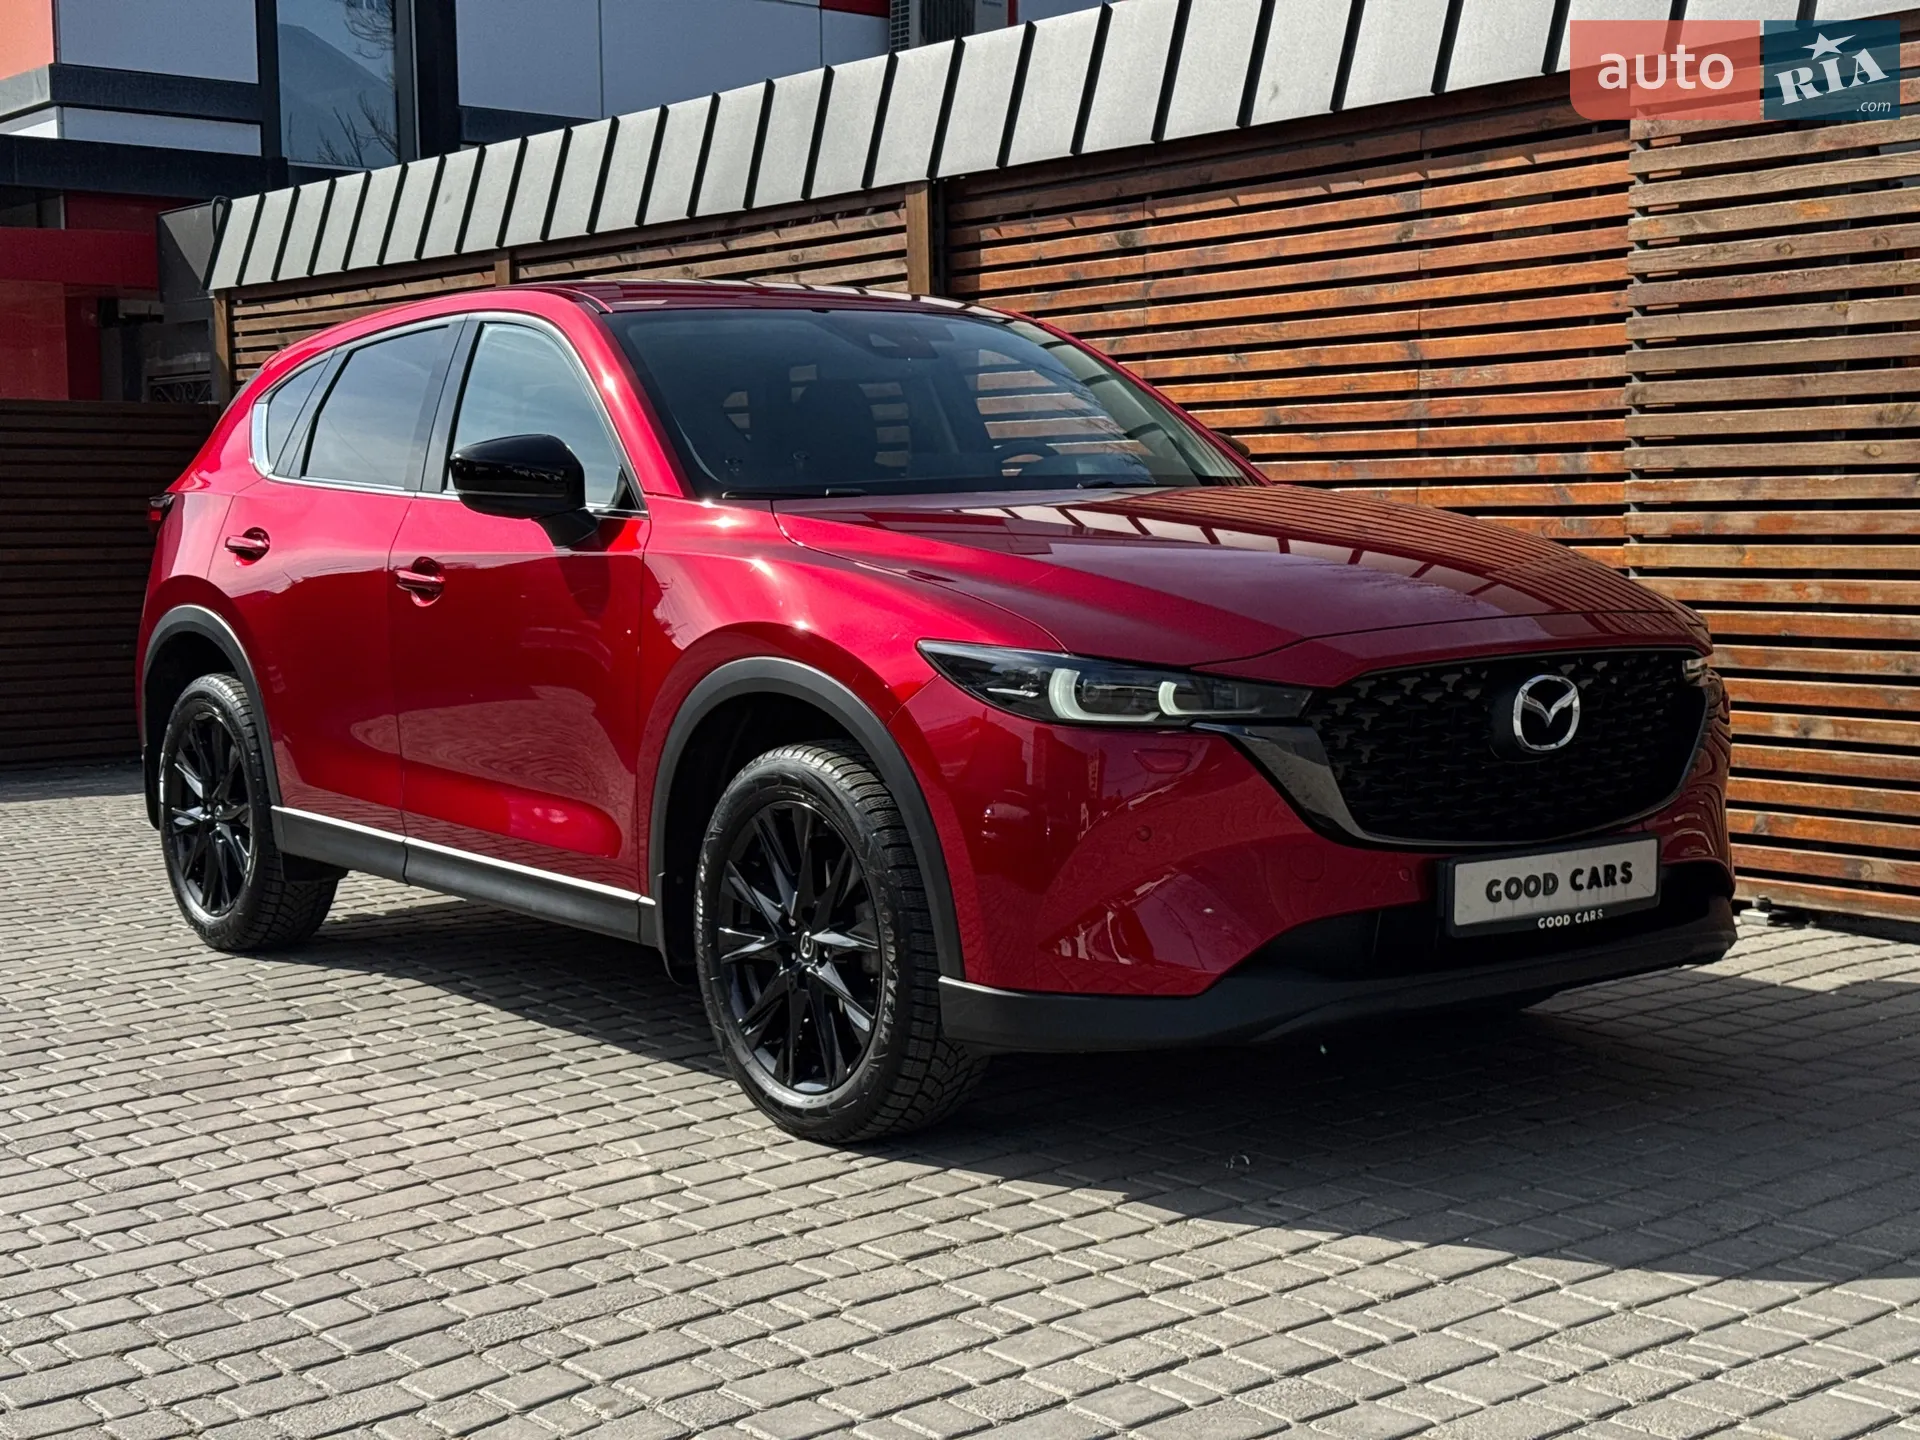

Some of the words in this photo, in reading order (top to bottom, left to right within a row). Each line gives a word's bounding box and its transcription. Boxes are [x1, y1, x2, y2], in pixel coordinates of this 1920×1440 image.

[1485, 871, 1559, 903] GOOD
[1569, 861, 1633, 892] CARS
[1537, 914, 1571, 929] GOOD
[1575, 909, 1604, 924] CARS
